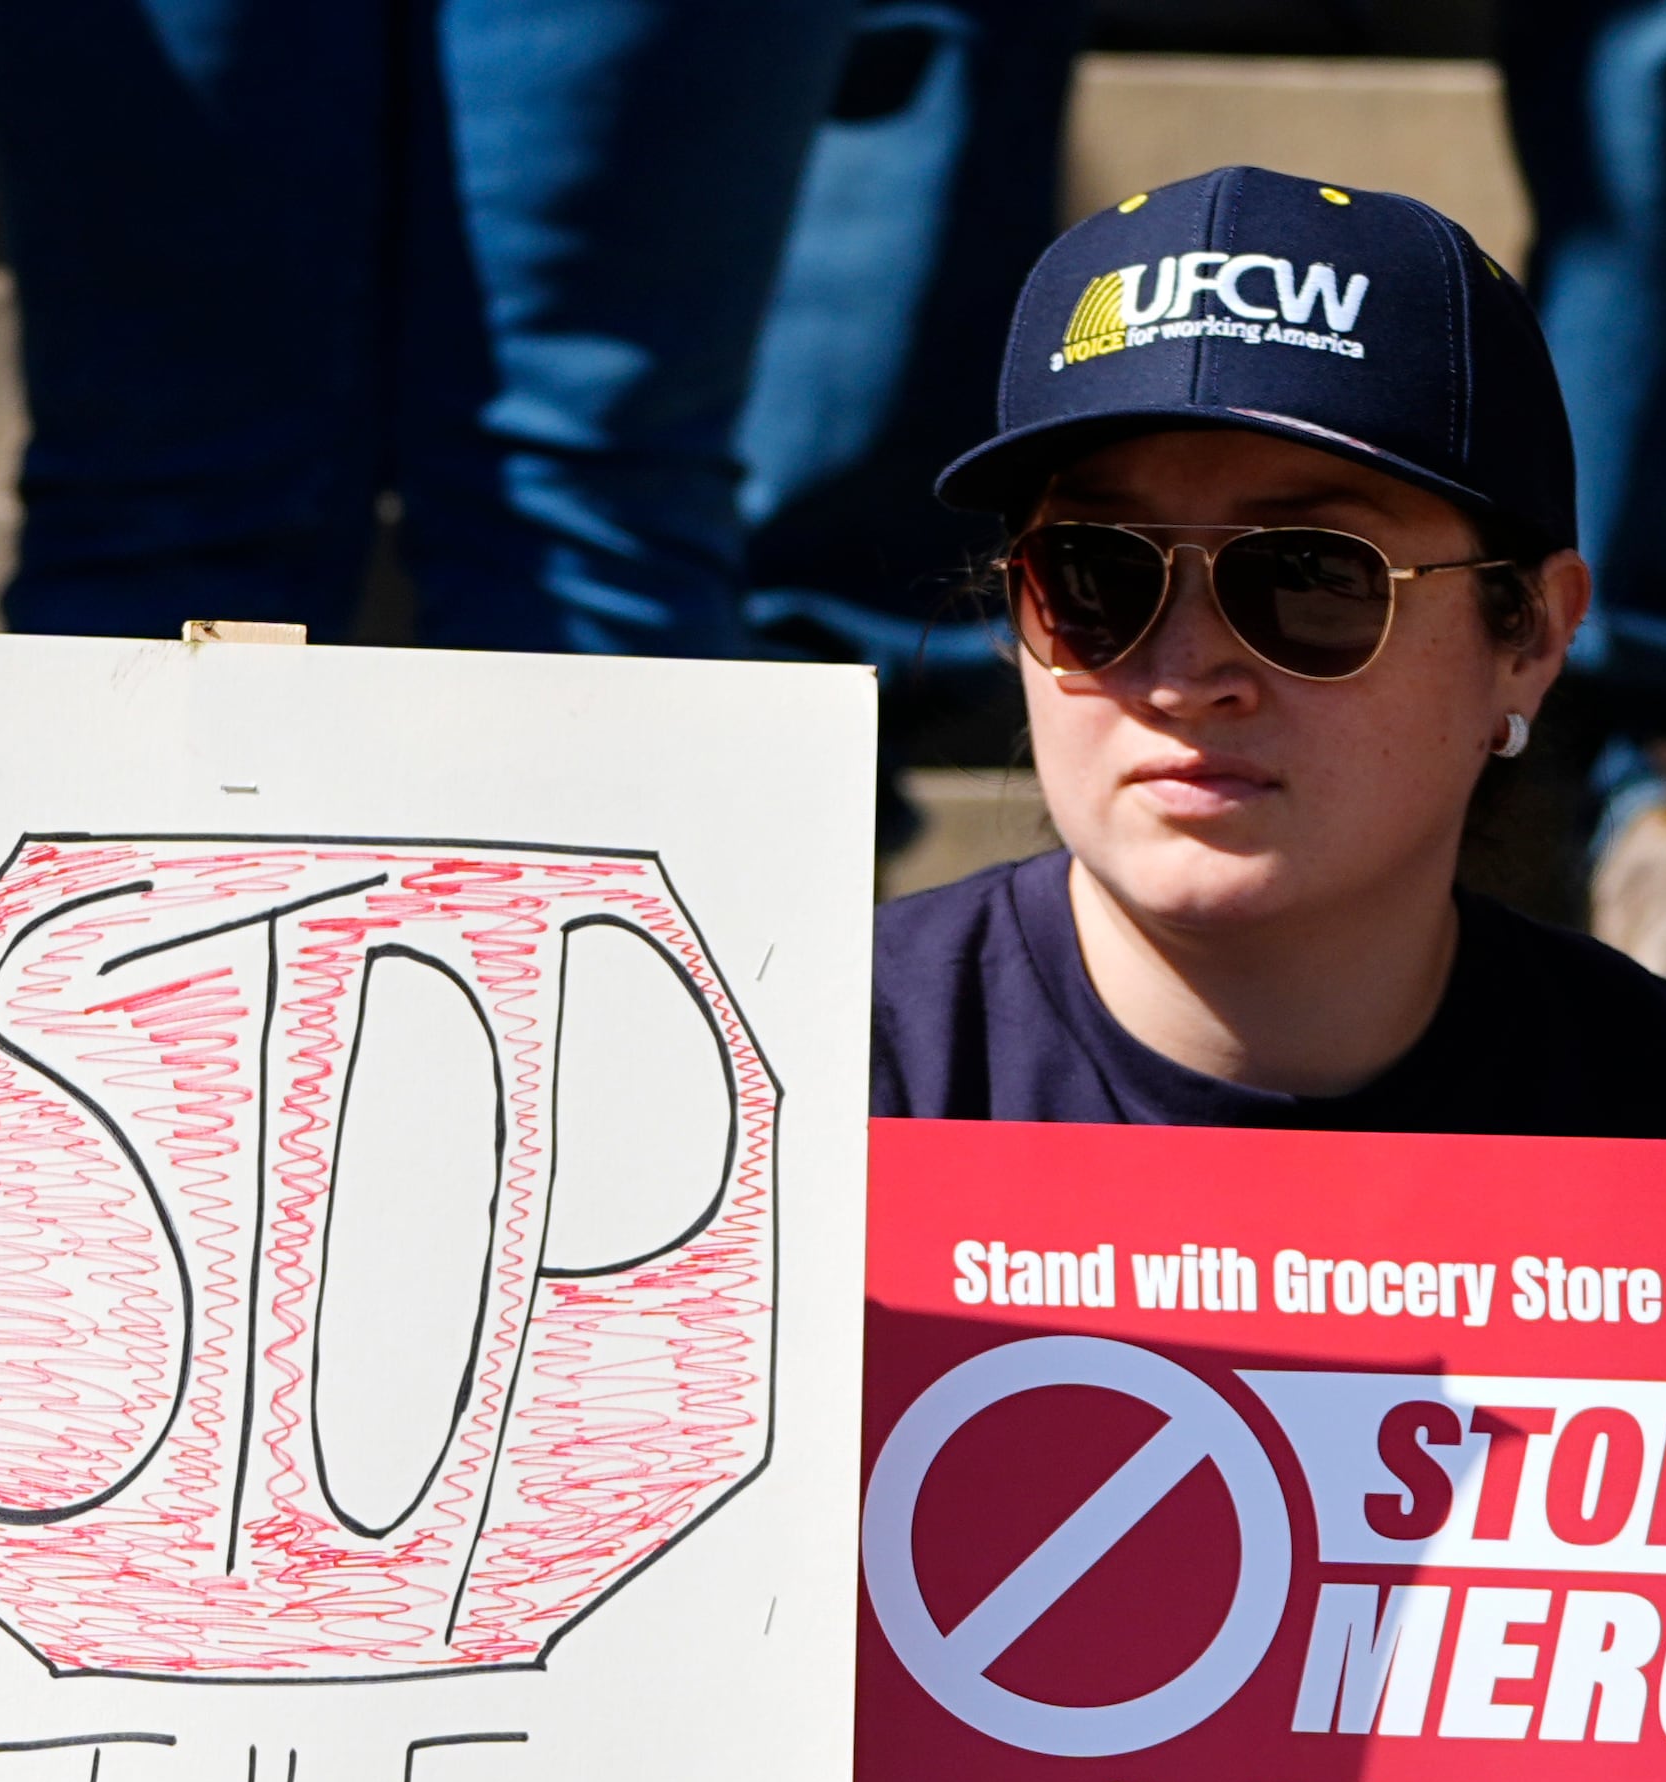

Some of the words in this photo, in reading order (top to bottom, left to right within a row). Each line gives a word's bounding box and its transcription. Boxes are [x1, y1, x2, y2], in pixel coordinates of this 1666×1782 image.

[1118, 251, 1370, 332] UFCW
[1048, 351, 1064, 372] a
[1063, 329, 1126, 364] VOICE
[1125, 322, 1160, 347] for
[1161, 313, 1263, 345] working
[1264, 321, 1366, 359] America
[953, 1239, 1116, 1309] Stand
[1130, 1243, 1258, 1313] with
[1273, 1248, 1497, 1328] Grocery
[1511, 1255, 1663, 1325] Store
